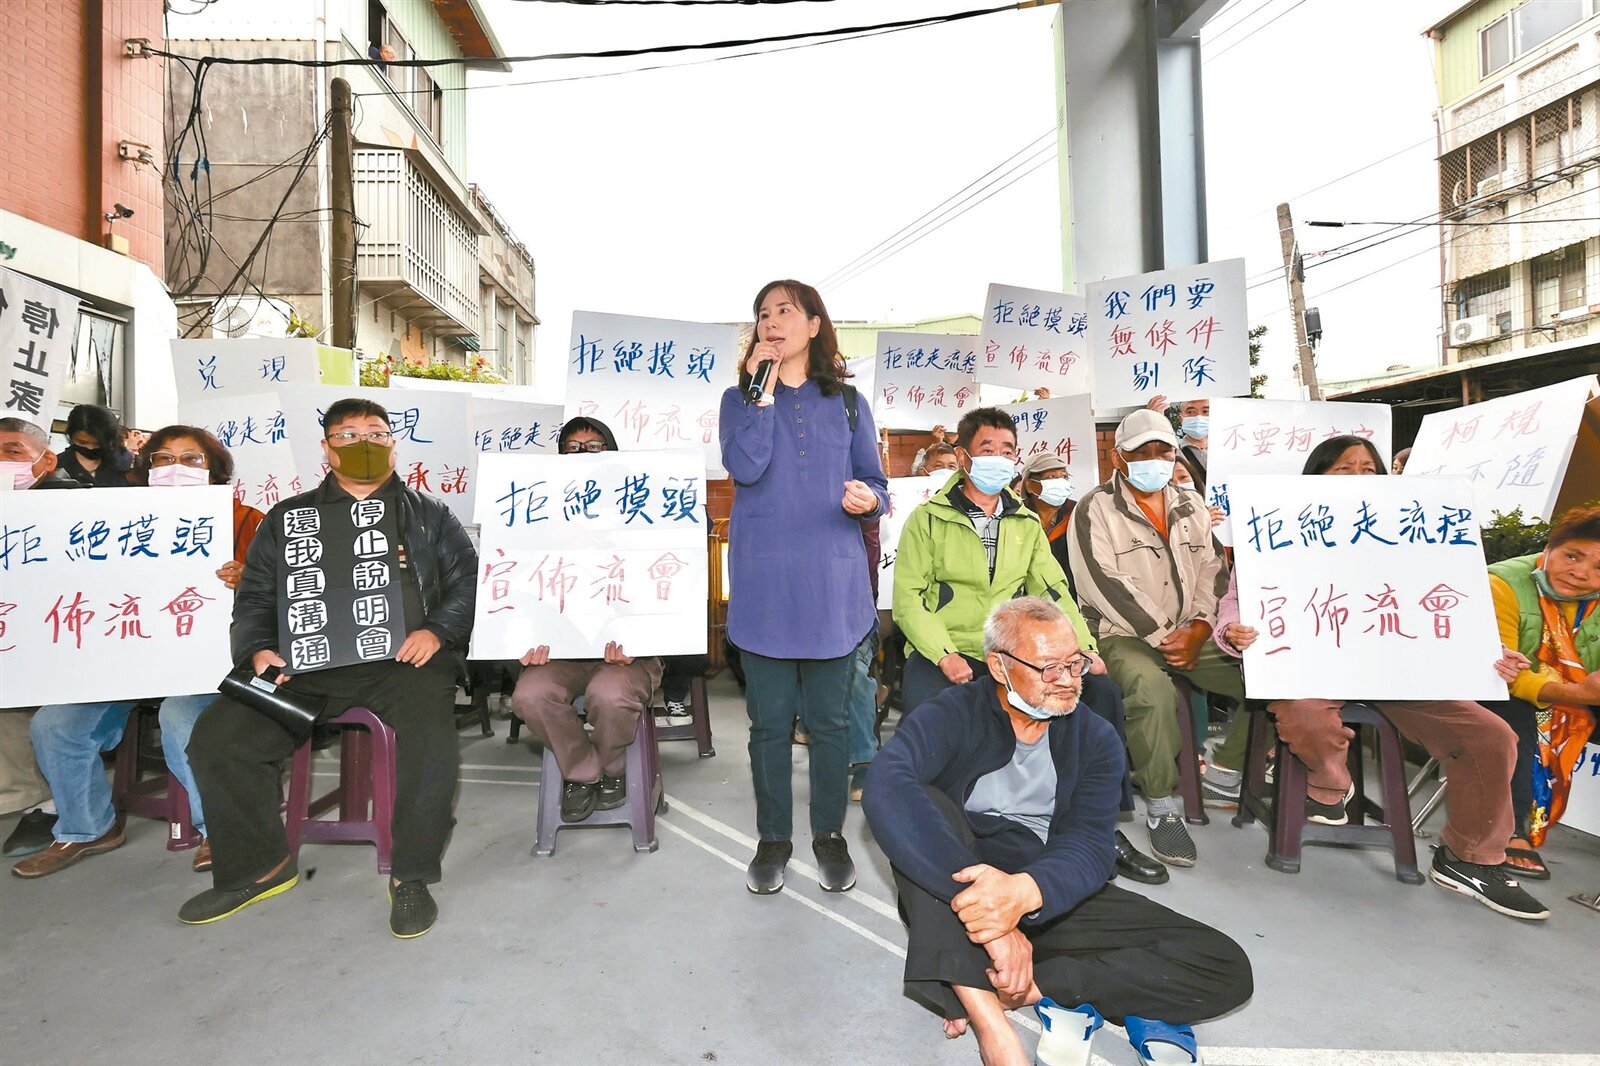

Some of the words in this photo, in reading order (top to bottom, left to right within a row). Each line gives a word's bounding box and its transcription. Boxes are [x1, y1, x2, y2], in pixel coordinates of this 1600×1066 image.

[993, 299, 1088, 338] 拒絕摸頭
[1102, 278, 1215, 320] 我們要
[571, 334, 716, 384] 拒絕摸頭
[883, 345, 977, 374] 拒絕走流程
[984, 339, 1081, 376] 宣佈流會
[1108, 316, 1224, 358] 無條件
[883, 382, 975, 410] 宣佈流會
[1132, 355, 1217, 392] 剔除
[191, 411, 290, 448] 絕走流
[495, 473, 700, 527] 拒絕摸頭
[0, 514, 214, 571] 拒絕摸頭
[1247, 499, 1478, 553] 拒絕走流程
[286, 508, 332, 669] 還我真溝通
[352, 500, 390, 660] 停止說明會
[482, 548, 689, 614] 宣佈流會
[1260, 583, 1469, 655] 宣佈流會
